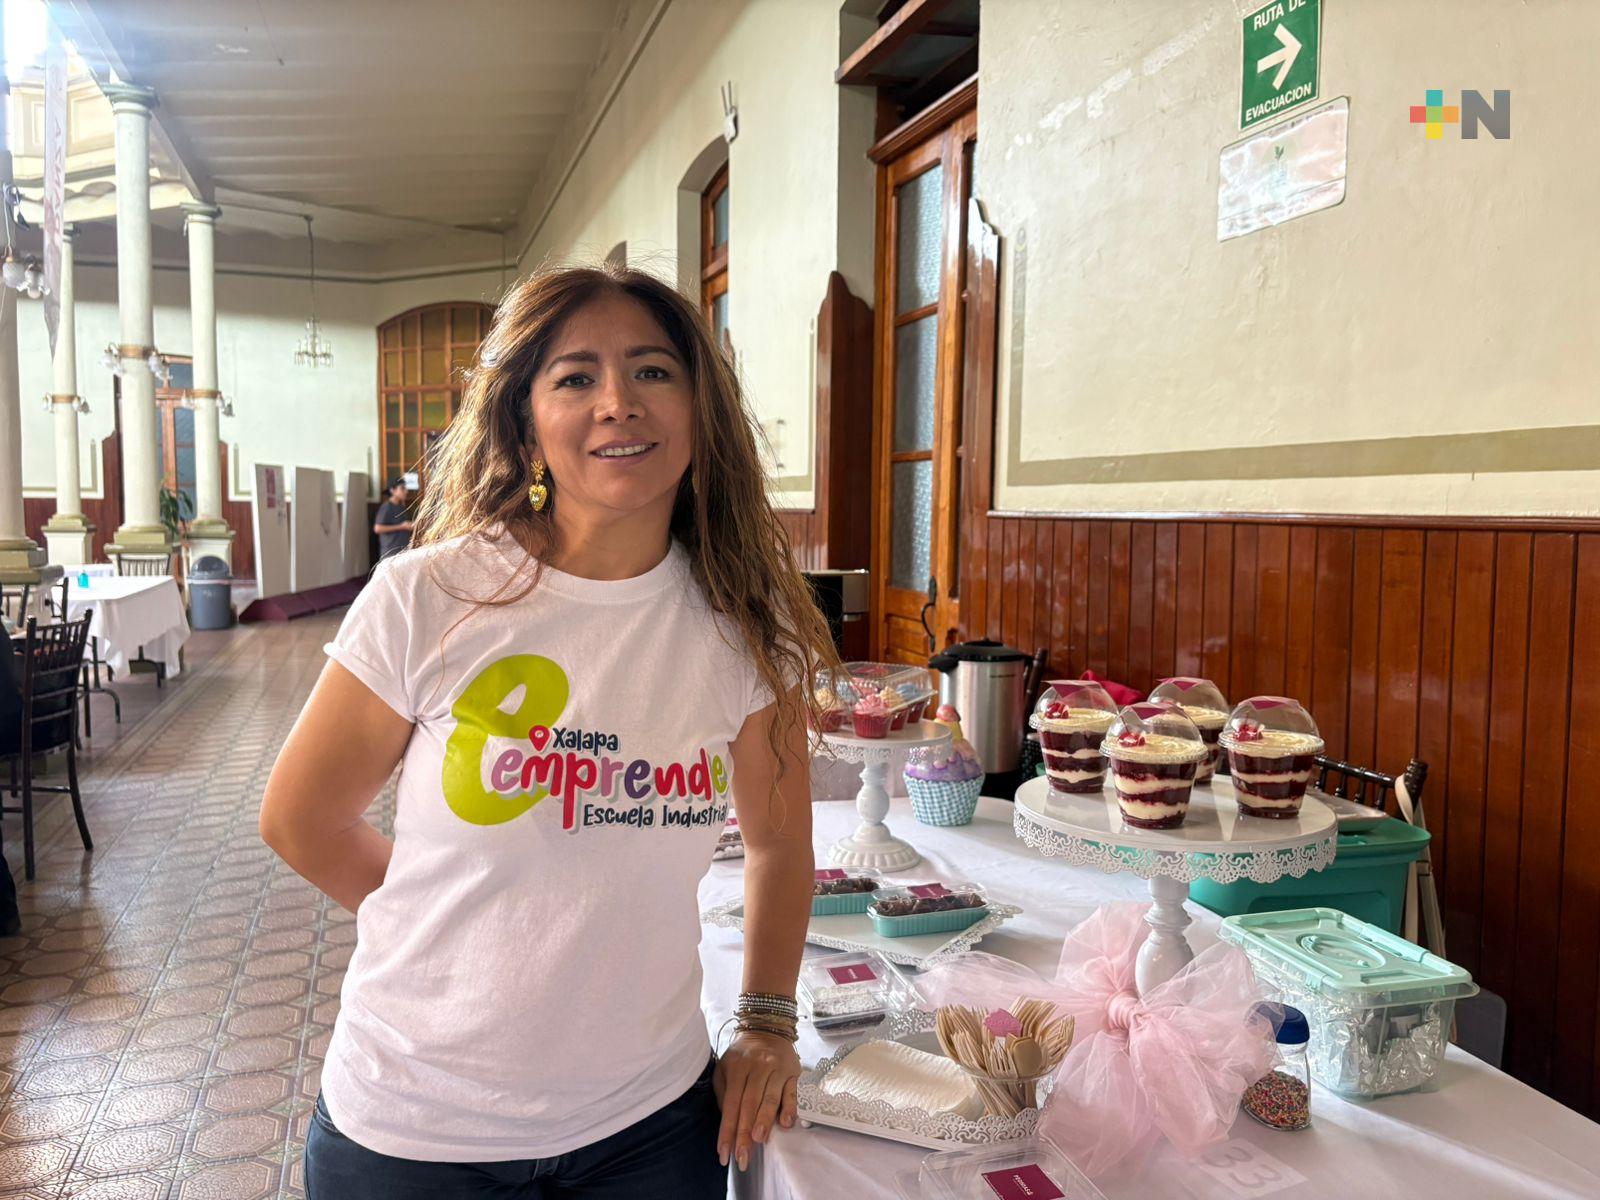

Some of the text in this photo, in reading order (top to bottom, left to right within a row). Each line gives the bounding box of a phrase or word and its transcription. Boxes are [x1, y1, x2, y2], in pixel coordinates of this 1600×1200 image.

[1254, 3, 1285, 31] RUTA
[1245, 82, 1312, 122] EVACUACION
[552, 727, 619, 757] Xalapa
[491, 748, 728, 829] emprende
[583, 803, 655, 828] Escuela
